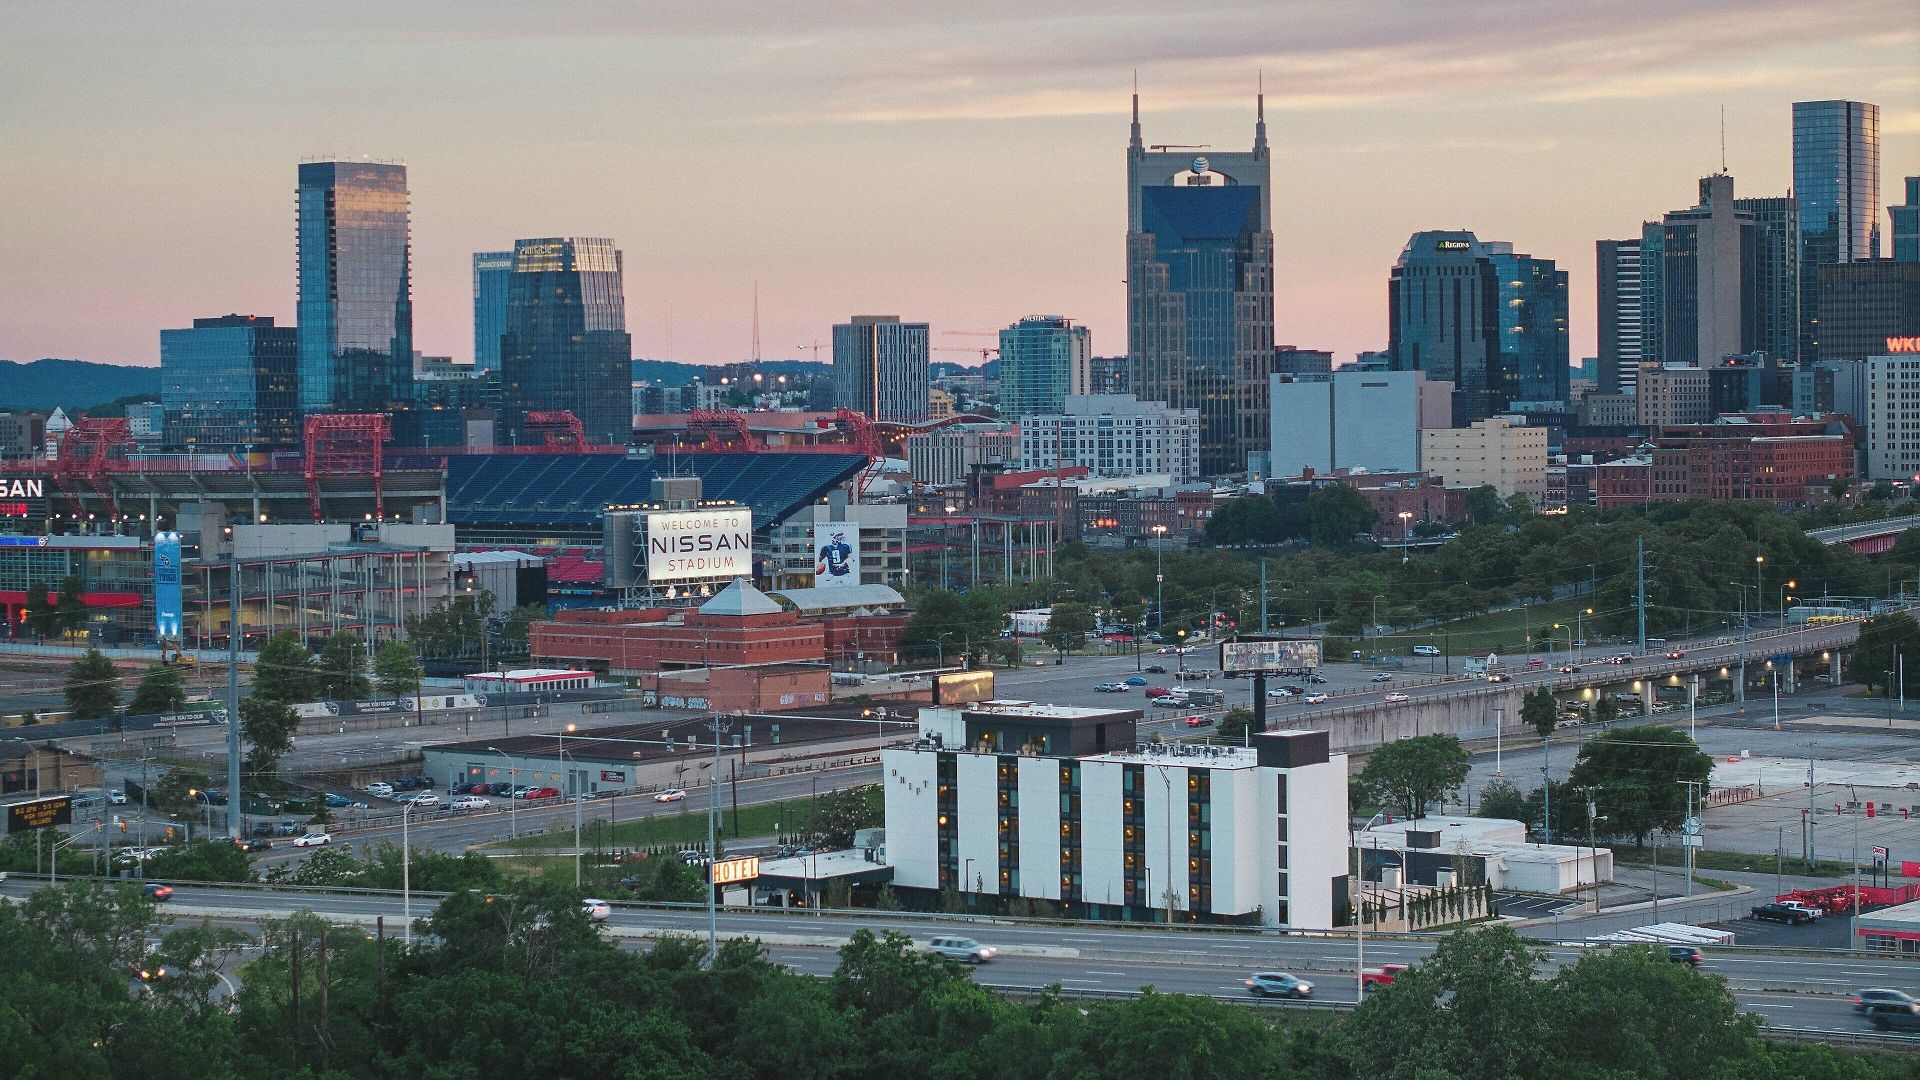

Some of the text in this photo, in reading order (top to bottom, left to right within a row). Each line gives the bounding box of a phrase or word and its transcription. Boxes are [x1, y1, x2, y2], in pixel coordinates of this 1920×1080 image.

[661, 518, 739, 530] WELCOME TO
[652, 532, 749, 554] NISSAN
[668, 556, 734, 572] STADIUM
[714, 860, 756, 881] HOTEL
